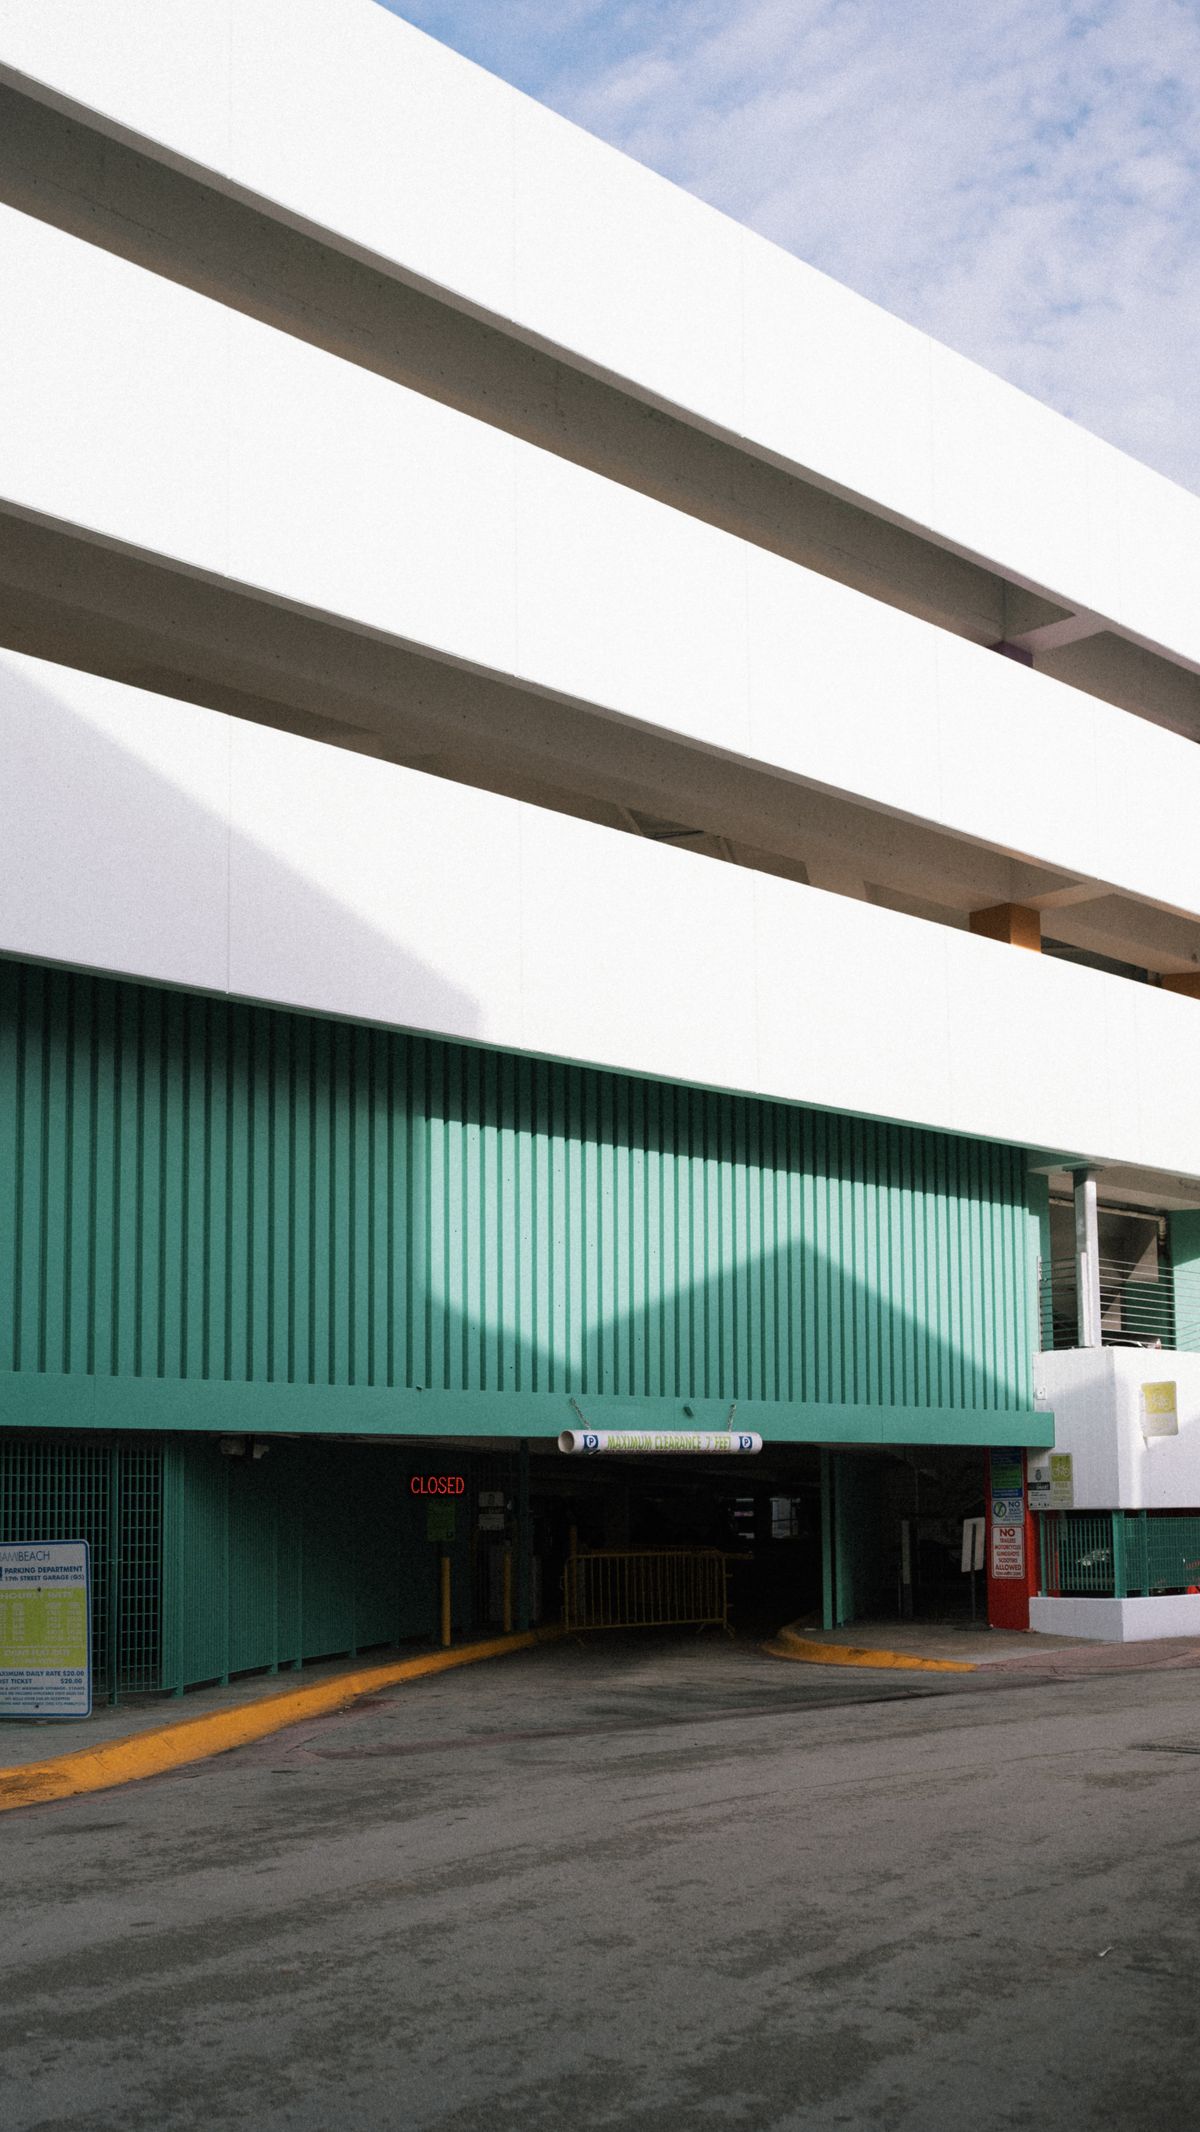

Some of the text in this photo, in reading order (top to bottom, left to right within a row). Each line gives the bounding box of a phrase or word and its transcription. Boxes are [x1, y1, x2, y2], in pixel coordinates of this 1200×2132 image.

[607, 1435, 652, 1449] MAXIMUM
[655, 1435, 701, 1449] CLEARANCE
[714, 1436, 731, 1449] FEET
[411, 1476, 465, 1494] CLOSED
[1000, 1528, 1015, 1537] NO
[37, 1565, 83, 1573] DEPARTMENT
